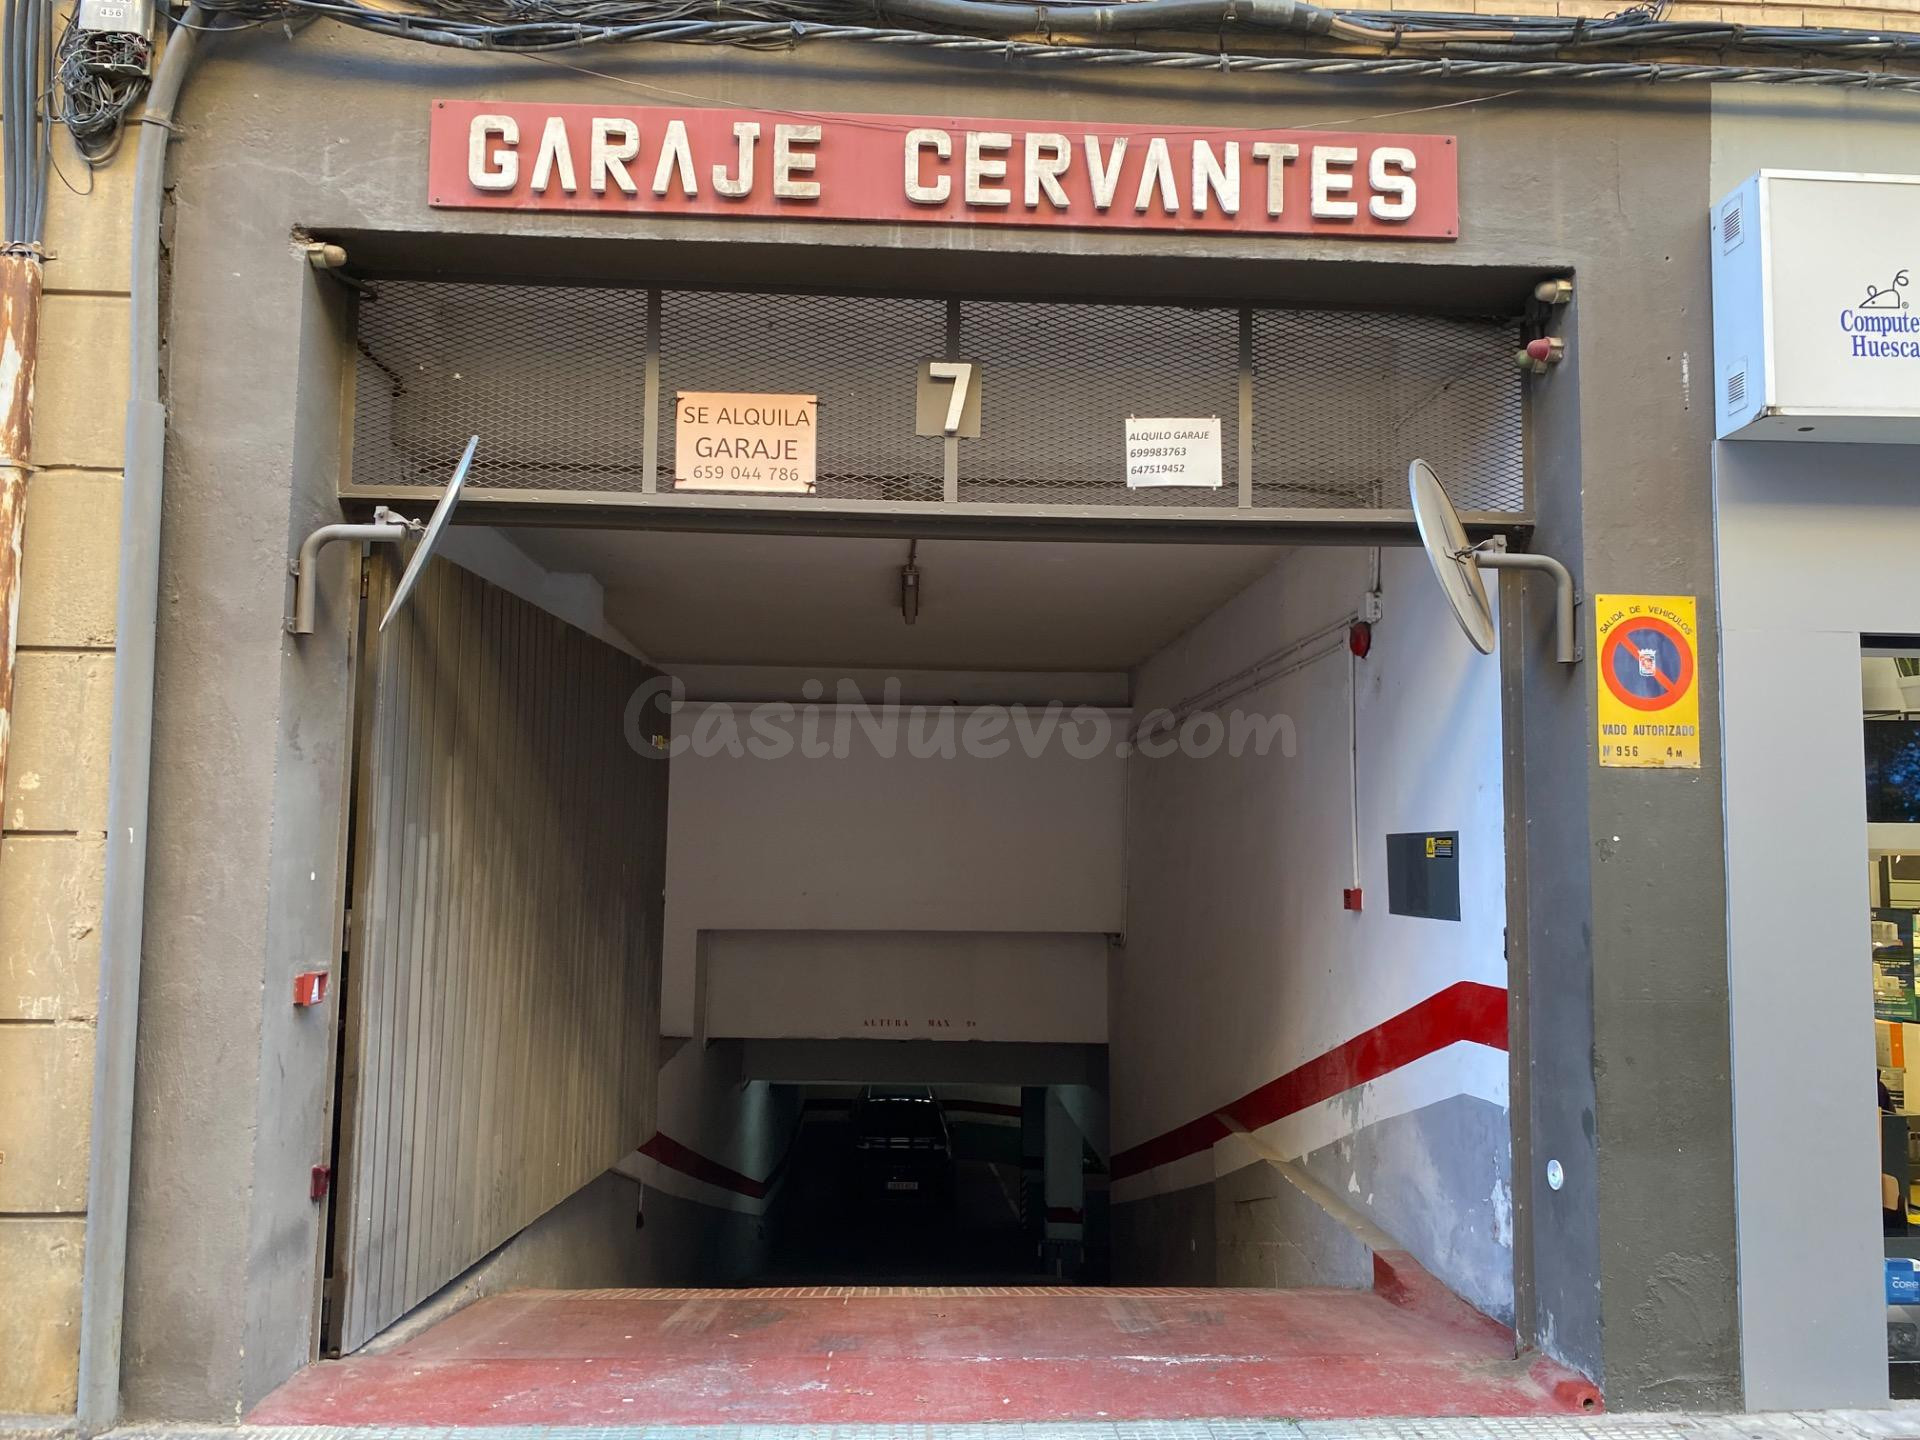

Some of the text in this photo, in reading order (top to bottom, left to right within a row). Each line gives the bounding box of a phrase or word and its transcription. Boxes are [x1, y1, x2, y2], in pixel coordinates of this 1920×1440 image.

[468, 114, 1417, 221] GARAJE CERVANTES
[1840, 309, 1920, 337] Compute
[1851, 335, 1920, 358] Huesca
[929, 362, 972, 433] 7
[683, 406, 811, 427] SE ALQUILA
[1129, 431, 1209, 441] ALQUILO GARAJE
[695, 437, 798, 460] GARAJE
[1130, 447, 1187, 458] 699983763
[693, 466, 799, 481] 659 044 786
[1131, 464, 1185, 475] 647519452
[1600, 605, 1693, 635] SALIDA DE VEHICULOS
[1602, 724, 1695, 736] VADO AUTORIZADO
[1616, 746, 1638, 757] 956
[1666, 746, 1673, 757] 4
[864, 1019, 909, 1027] ALTURA
